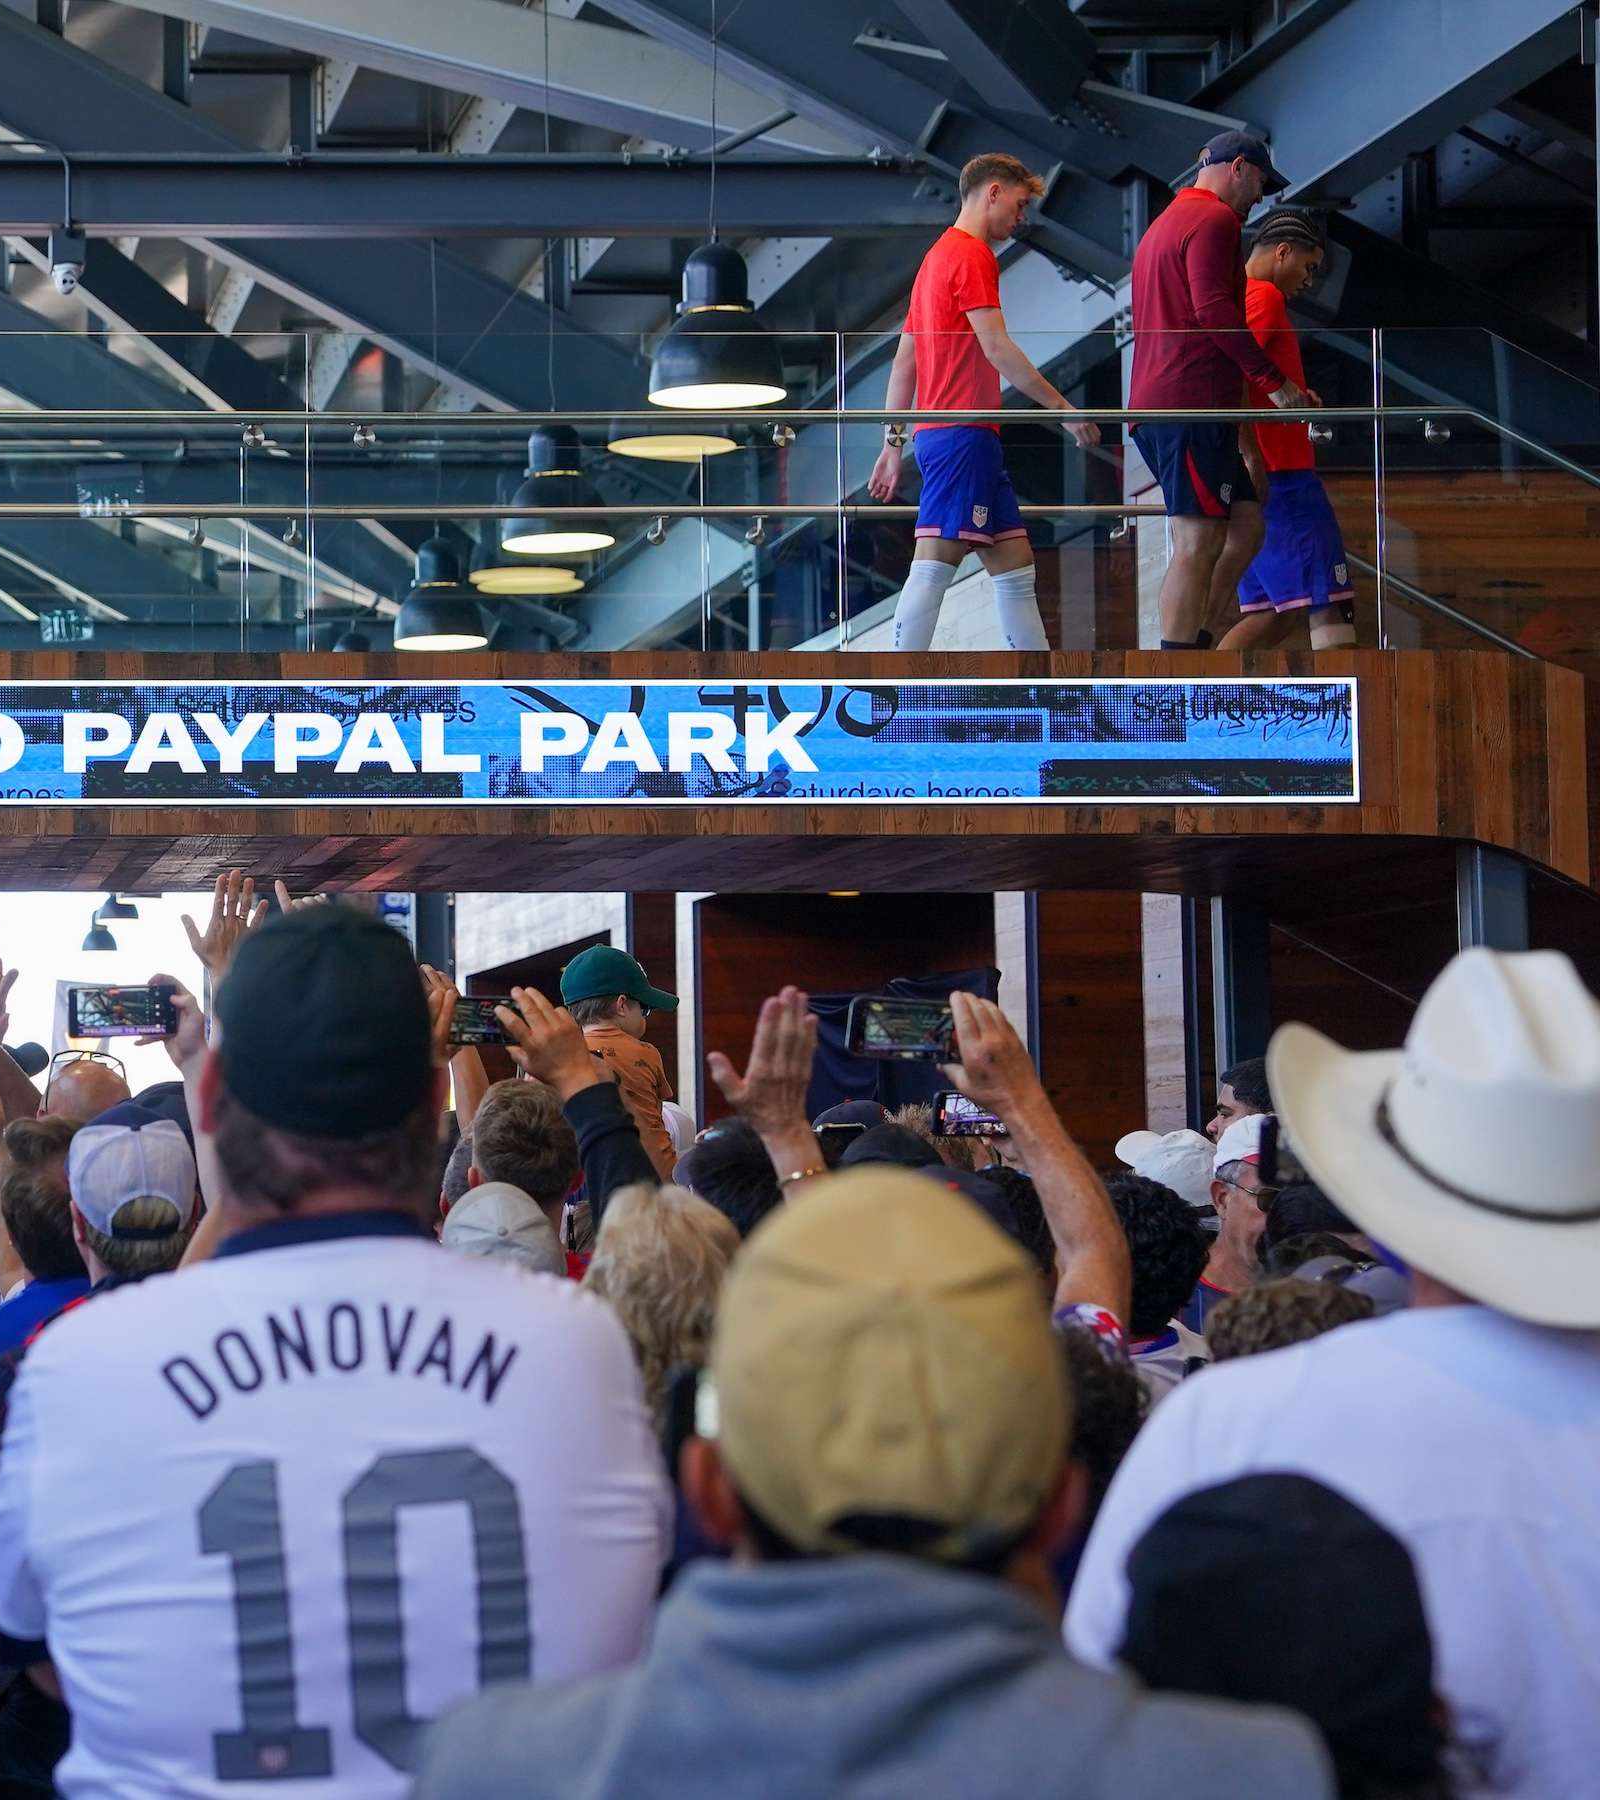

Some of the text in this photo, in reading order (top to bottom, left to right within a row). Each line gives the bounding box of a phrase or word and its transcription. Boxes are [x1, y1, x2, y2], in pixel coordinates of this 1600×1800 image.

[63, 712, 481, 773] PAYPAL
[520, 712, 818, 773] PARK
[160, 1302, 519, 1421] DONOVAN
[197, 1445, 532, 1782] 10
